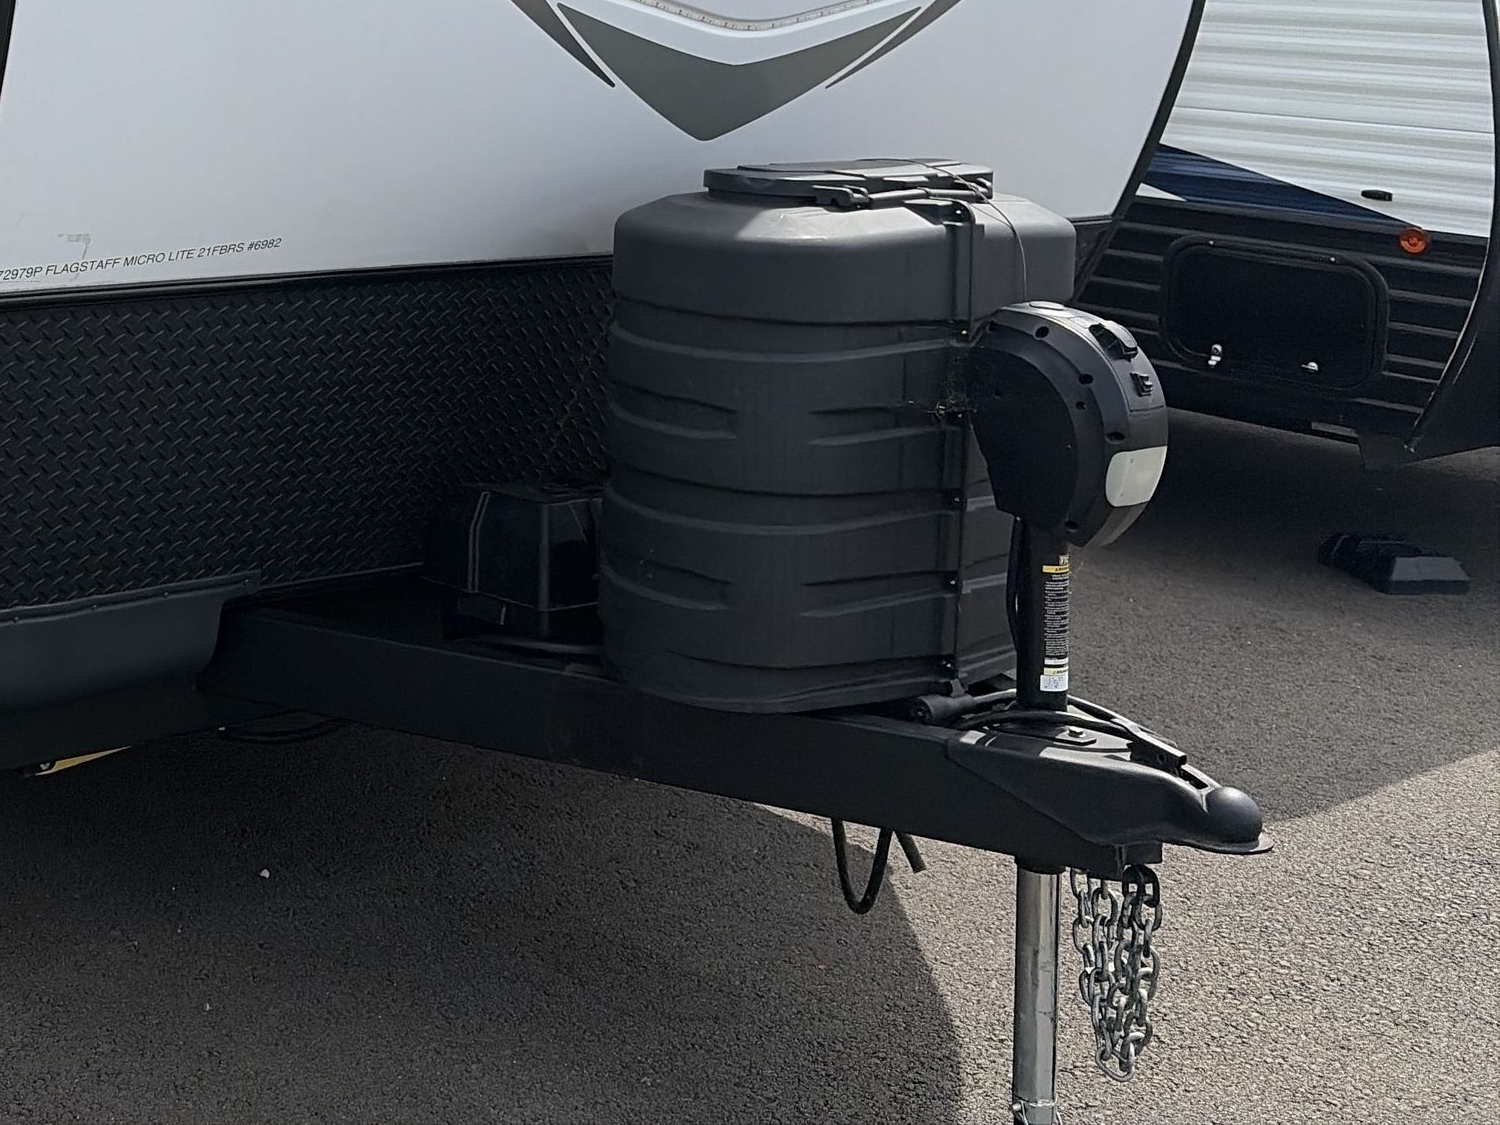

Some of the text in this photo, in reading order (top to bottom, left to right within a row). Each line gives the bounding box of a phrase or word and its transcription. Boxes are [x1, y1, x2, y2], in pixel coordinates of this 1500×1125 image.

[45, 257, 121, 276] FLAGSTAFF
[123, 252, 166, 267] MICRO
[168, 248, 196, 262] LITE
[197, 242, 245, 258] 21FBRS
[247, 237, 282, 251] #6982
